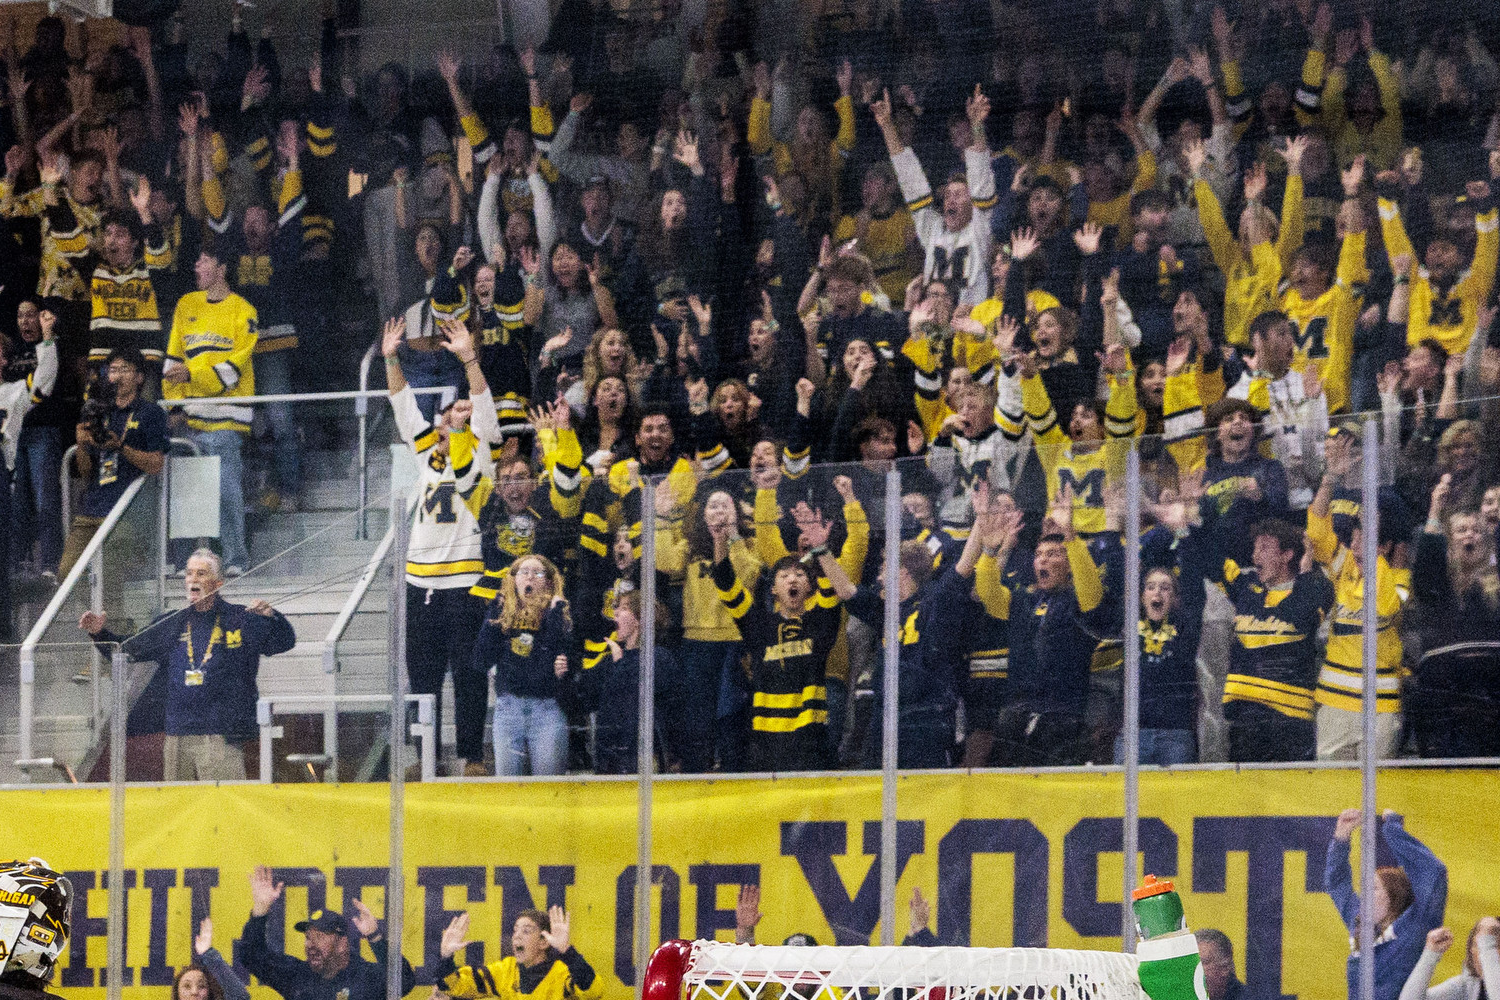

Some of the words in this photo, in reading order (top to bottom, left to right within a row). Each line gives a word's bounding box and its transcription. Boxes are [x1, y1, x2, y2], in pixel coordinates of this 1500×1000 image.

[1290, 316, 1329, 358] M
[1058, 468, 1107, 508] M
[614, 863, 761, 986] OF
